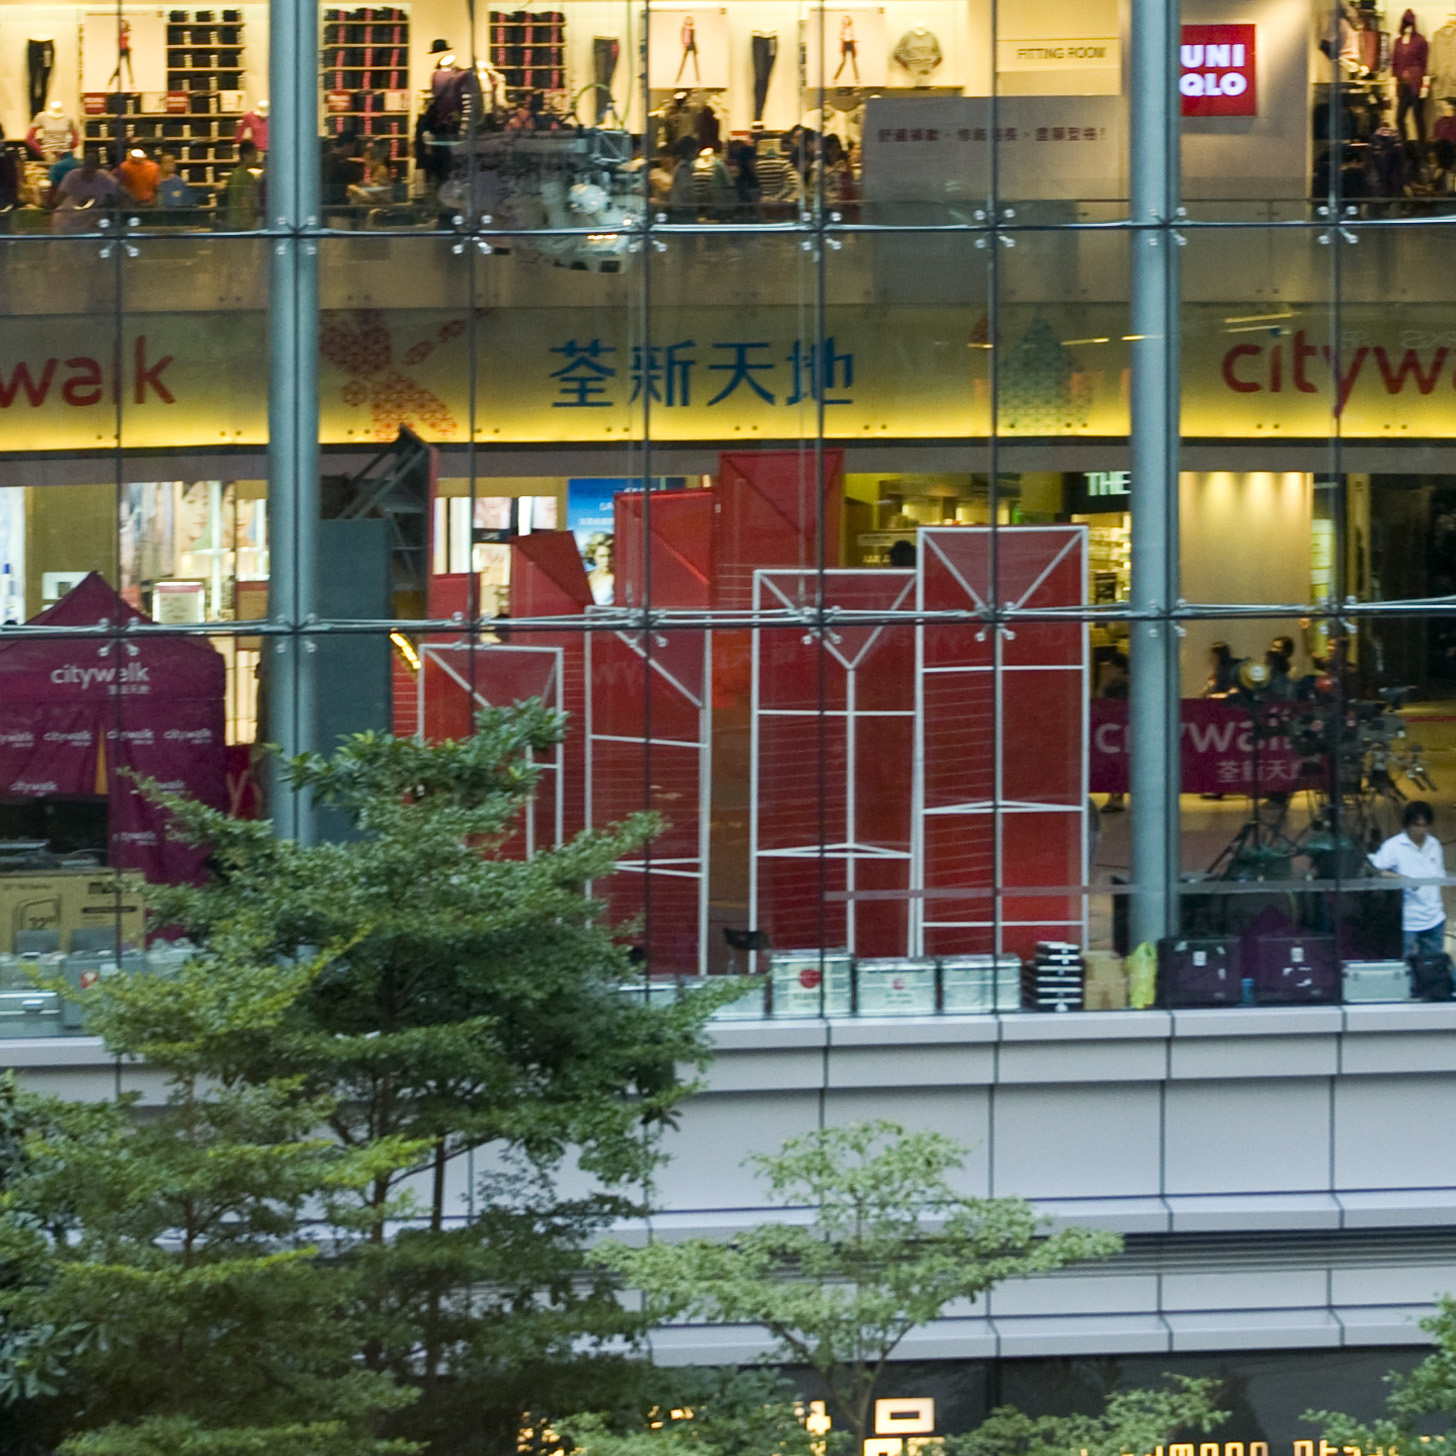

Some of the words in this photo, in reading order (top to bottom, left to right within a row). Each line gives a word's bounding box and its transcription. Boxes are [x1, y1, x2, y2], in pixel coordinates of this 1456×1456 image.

[1180, 43, 1246, 68] UNI
[1179, 72, 1247, 97] QLO
[549, 337, 854, 407] 荃新天地
[1084, 470, 1132, 496] THE
[50, 662, 150, 690] citywalk
